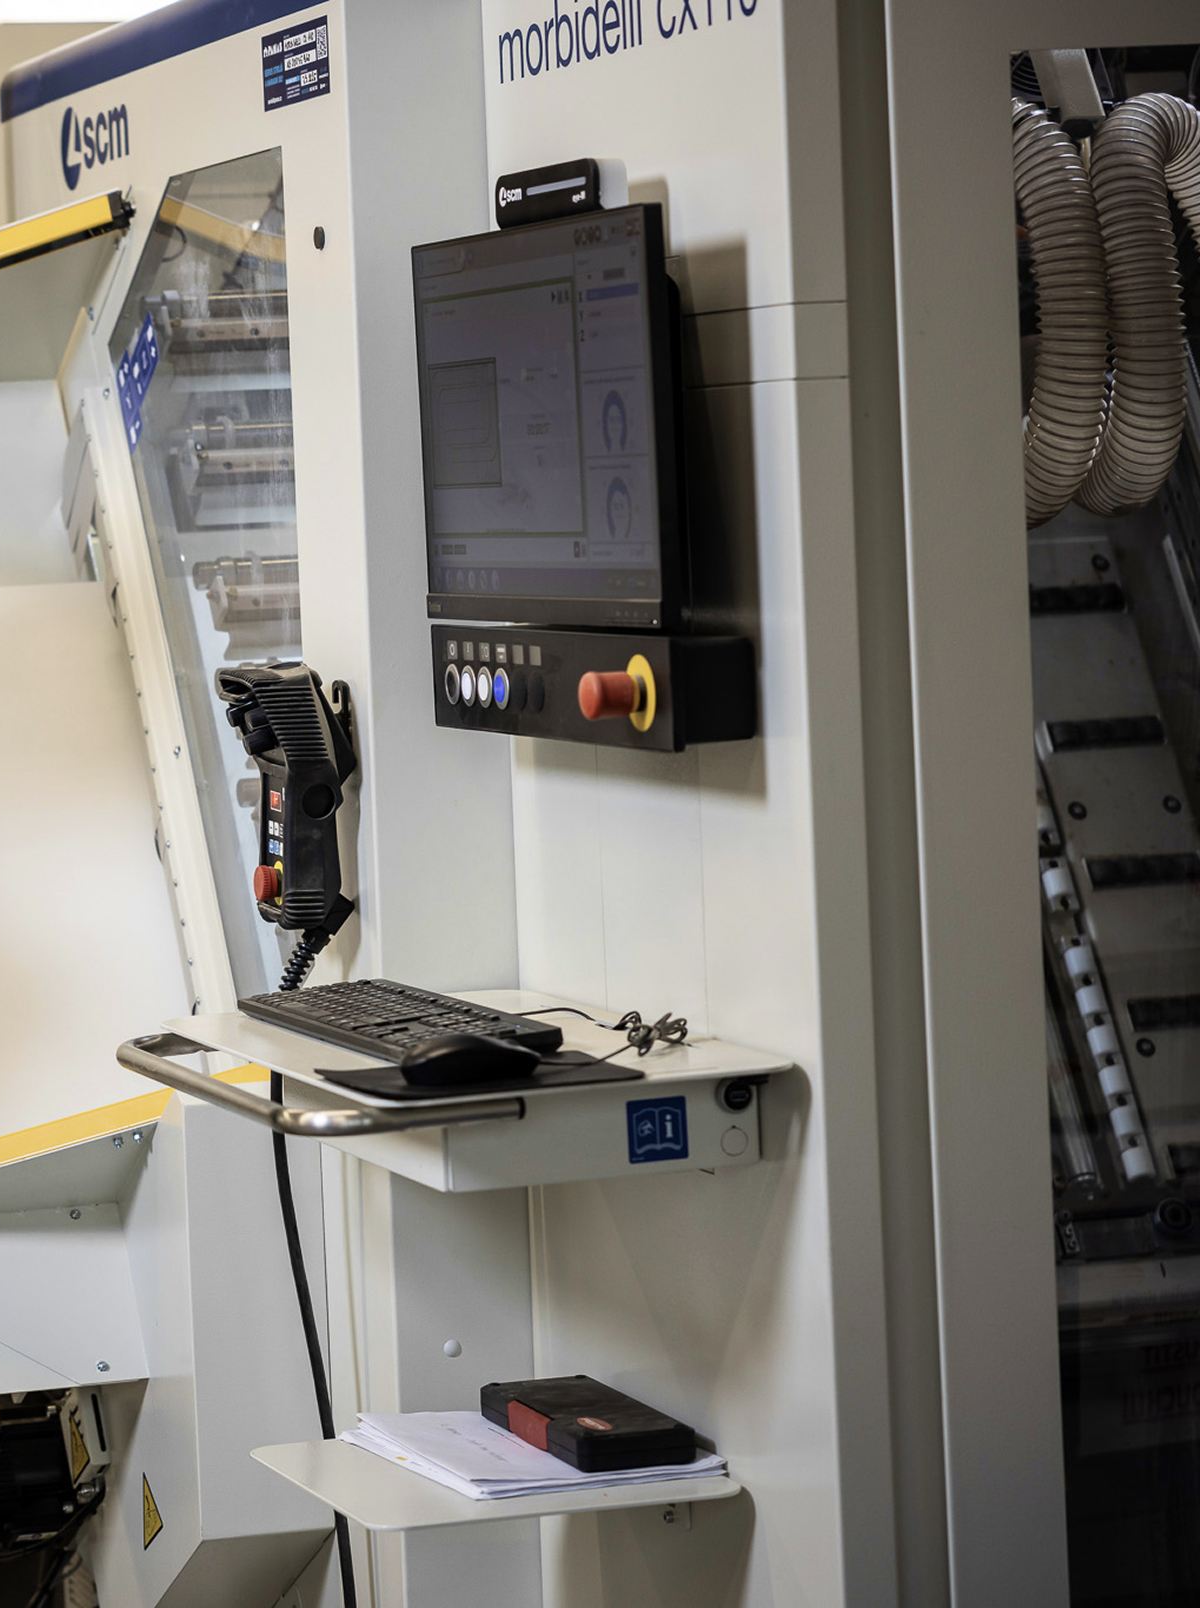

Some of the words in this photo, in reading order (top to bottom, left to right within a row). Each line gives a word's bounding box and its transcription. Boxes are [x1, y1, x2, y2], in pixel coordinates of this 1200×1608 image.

[499, 0, 642, 84] morbidelli
[83, 104, 129, 169] scm
[507, 188, 522, 202] scm
